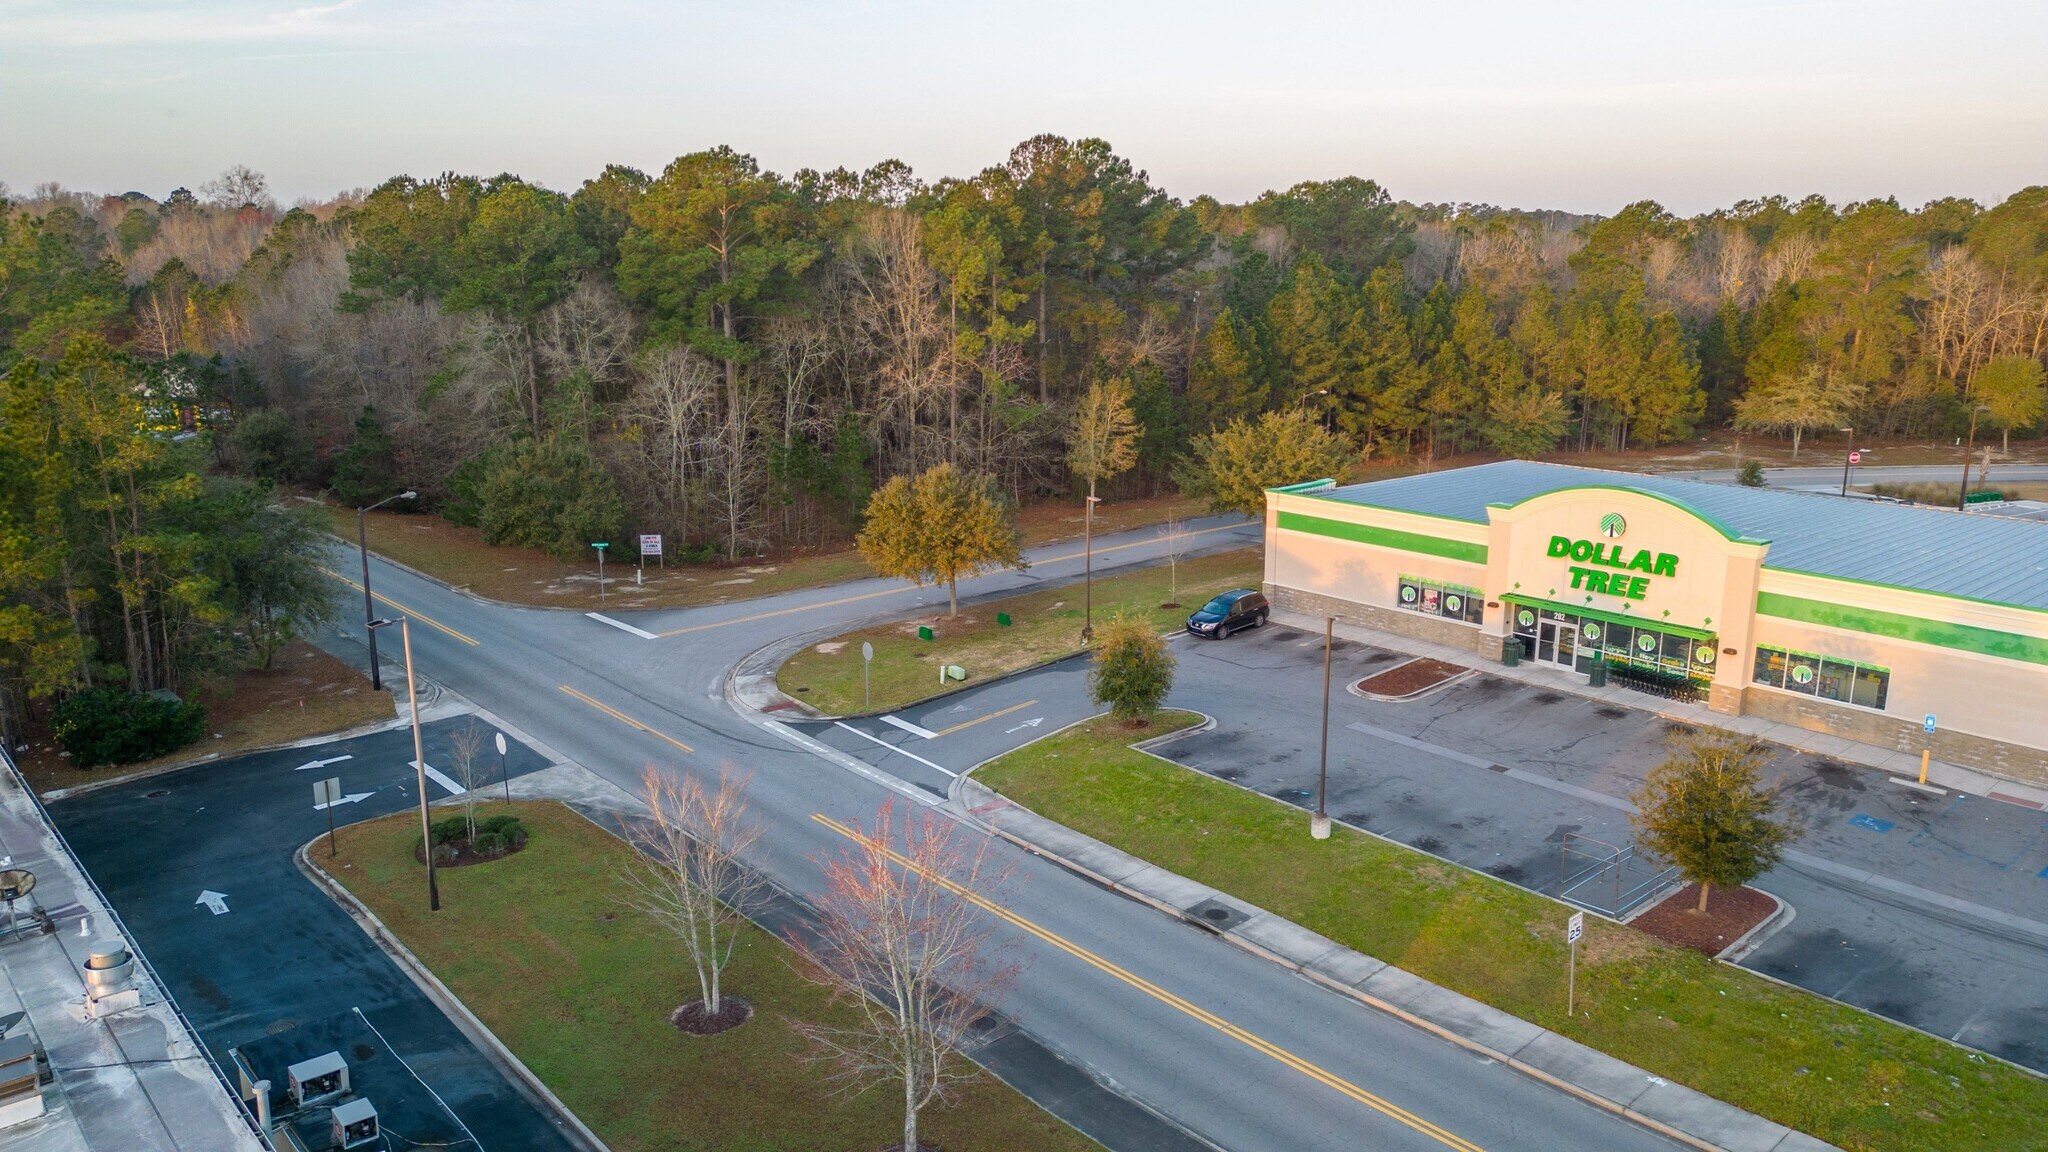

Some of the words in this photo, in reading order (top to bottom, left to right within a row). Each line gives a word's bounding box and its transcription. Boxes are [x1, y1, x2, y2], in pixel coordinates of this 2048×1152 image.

[1547, 535, 1679, 578] DOLLAR
[1569, 566, 1650, 600] TREE
[1554, 612, 1566, 621] 202
[1570, 925, 1581, 941] 25
